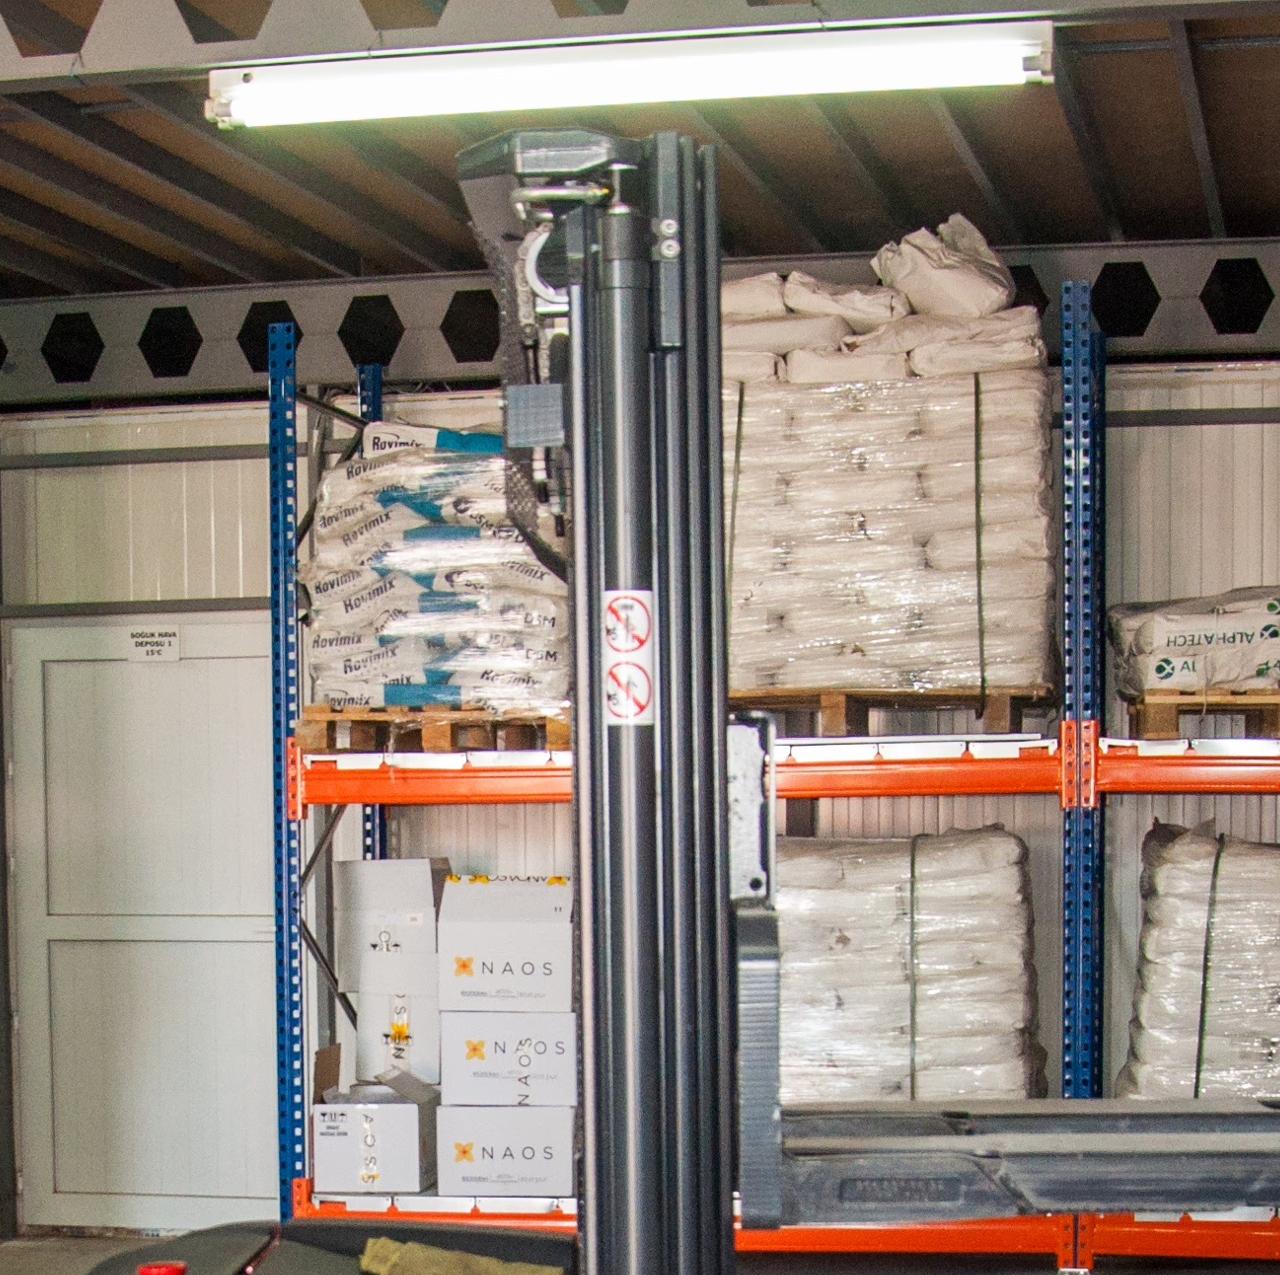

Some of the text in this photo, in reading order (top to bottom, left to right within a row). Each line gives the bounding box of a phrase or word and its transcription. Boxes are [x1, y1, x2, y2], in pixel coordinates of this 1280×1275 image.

[1166, 630, 1255, 648] ALPHATECH
[481, 960, 554, 977] NAOS
[481, 1145, 554, 1161] NAOS
